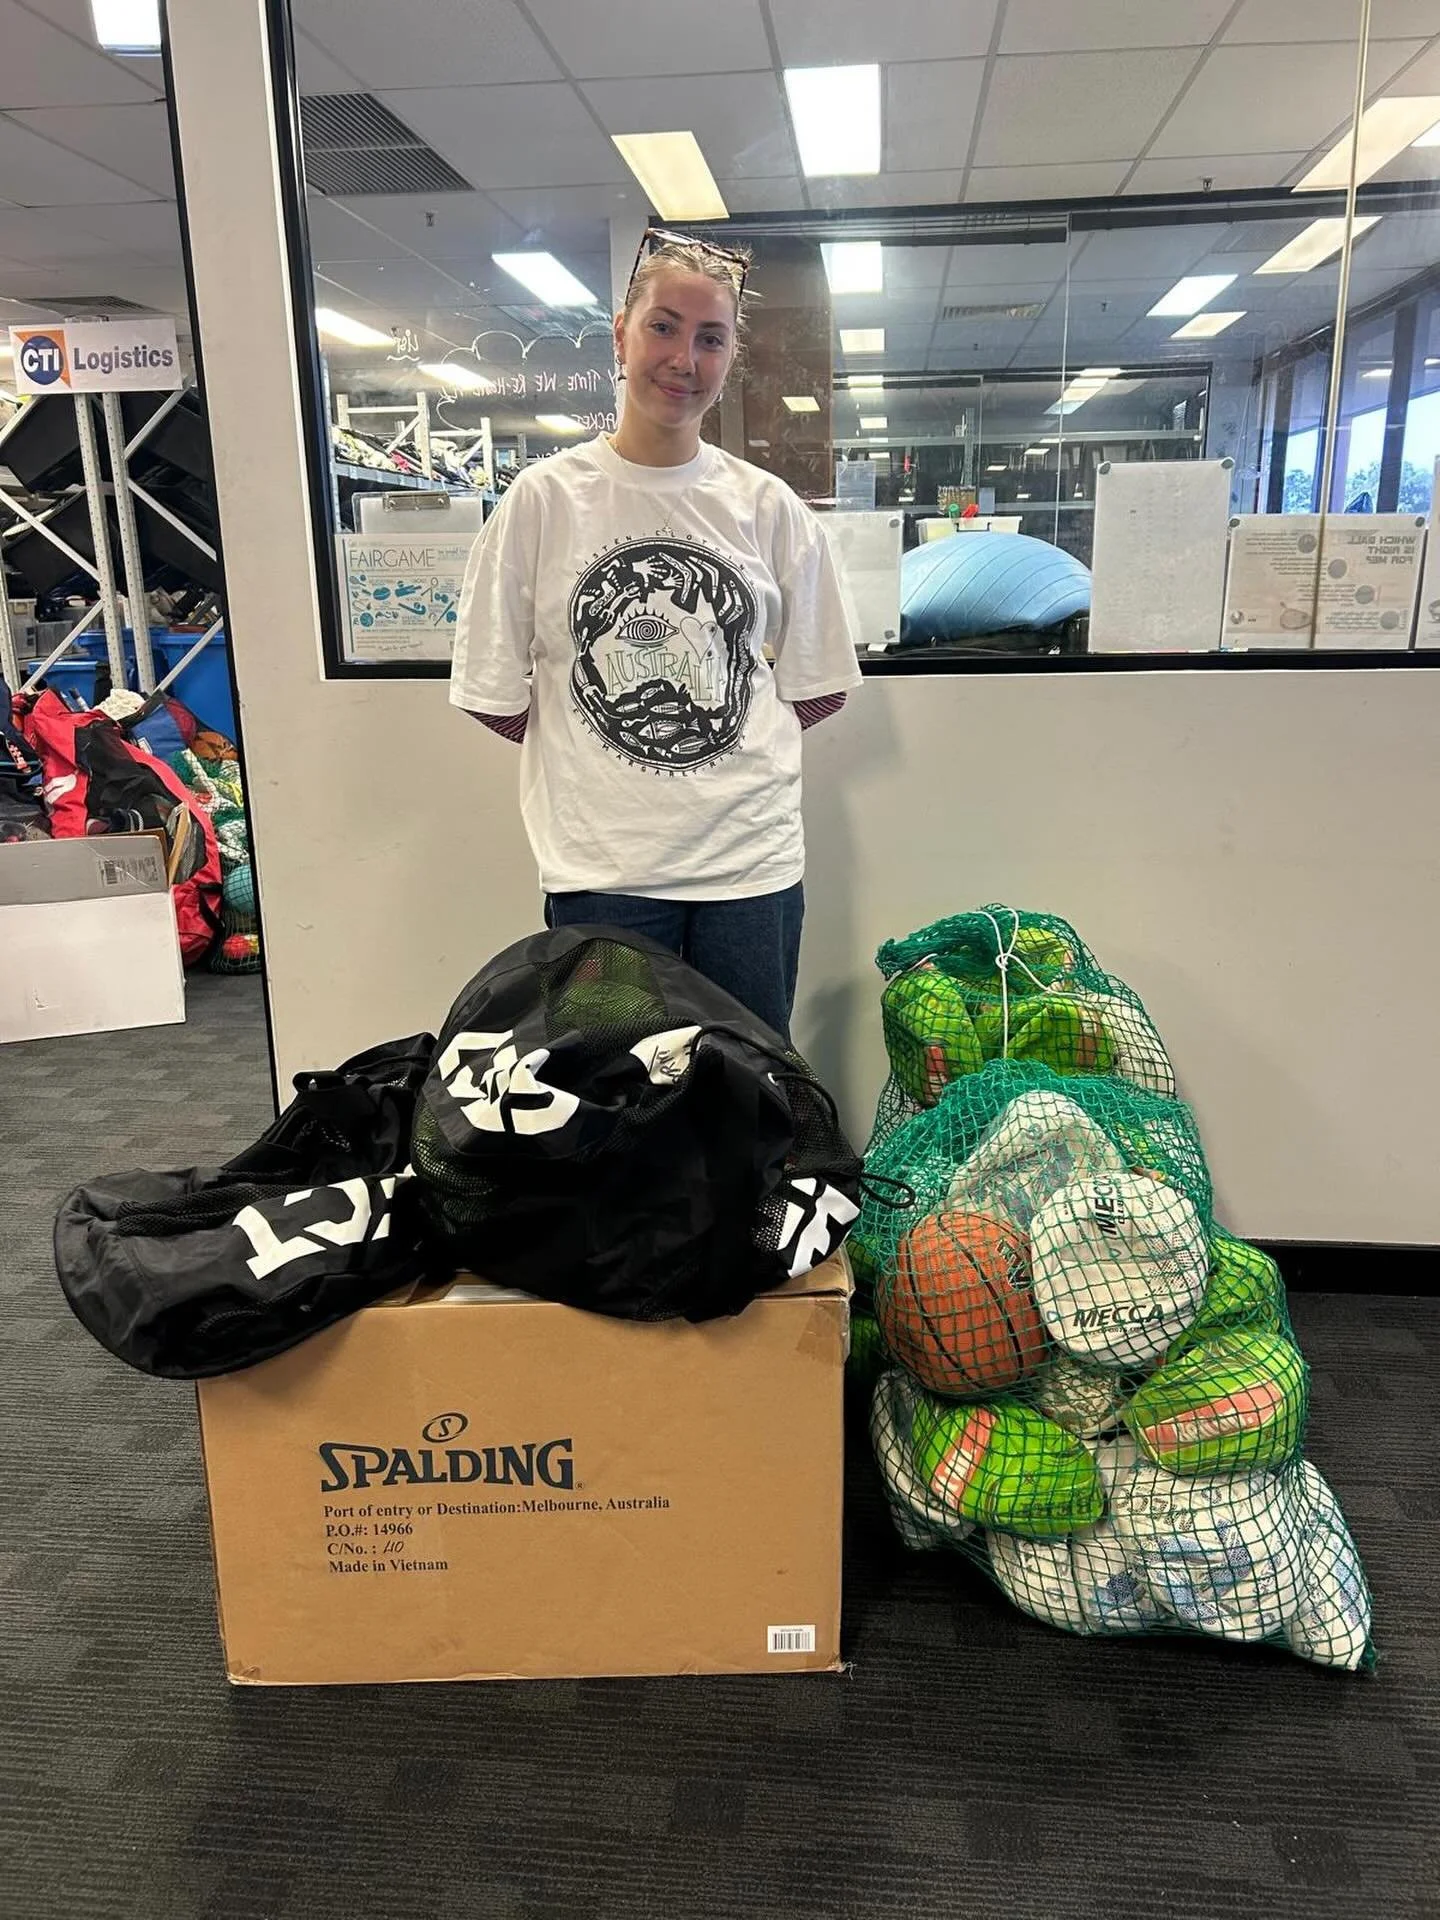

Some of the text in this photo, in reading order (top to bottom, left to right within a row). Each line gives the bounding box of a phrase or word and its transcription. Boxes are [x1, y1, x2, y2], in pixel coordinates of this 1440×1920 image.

[23, 345, 173, 374] CTI Logistics
[349, 549, 437, 568] FAIRGAME
[1073, 1303, 1165, 1328] MECCA
[319, 1438, 573, 1492] SPALDING
[324, 1505, 354, 1517] Port
[359, 1504, 373, 1517] of
[376, 1504, 413, 1519] entry
[418, 1506, 432, 1515] or
[606, 1496, 670, 1510] Australia
[326, 1523, 413, 1537] P.O.#: 14966
[329, 1559, 448, 1573] Made in Vietnam
